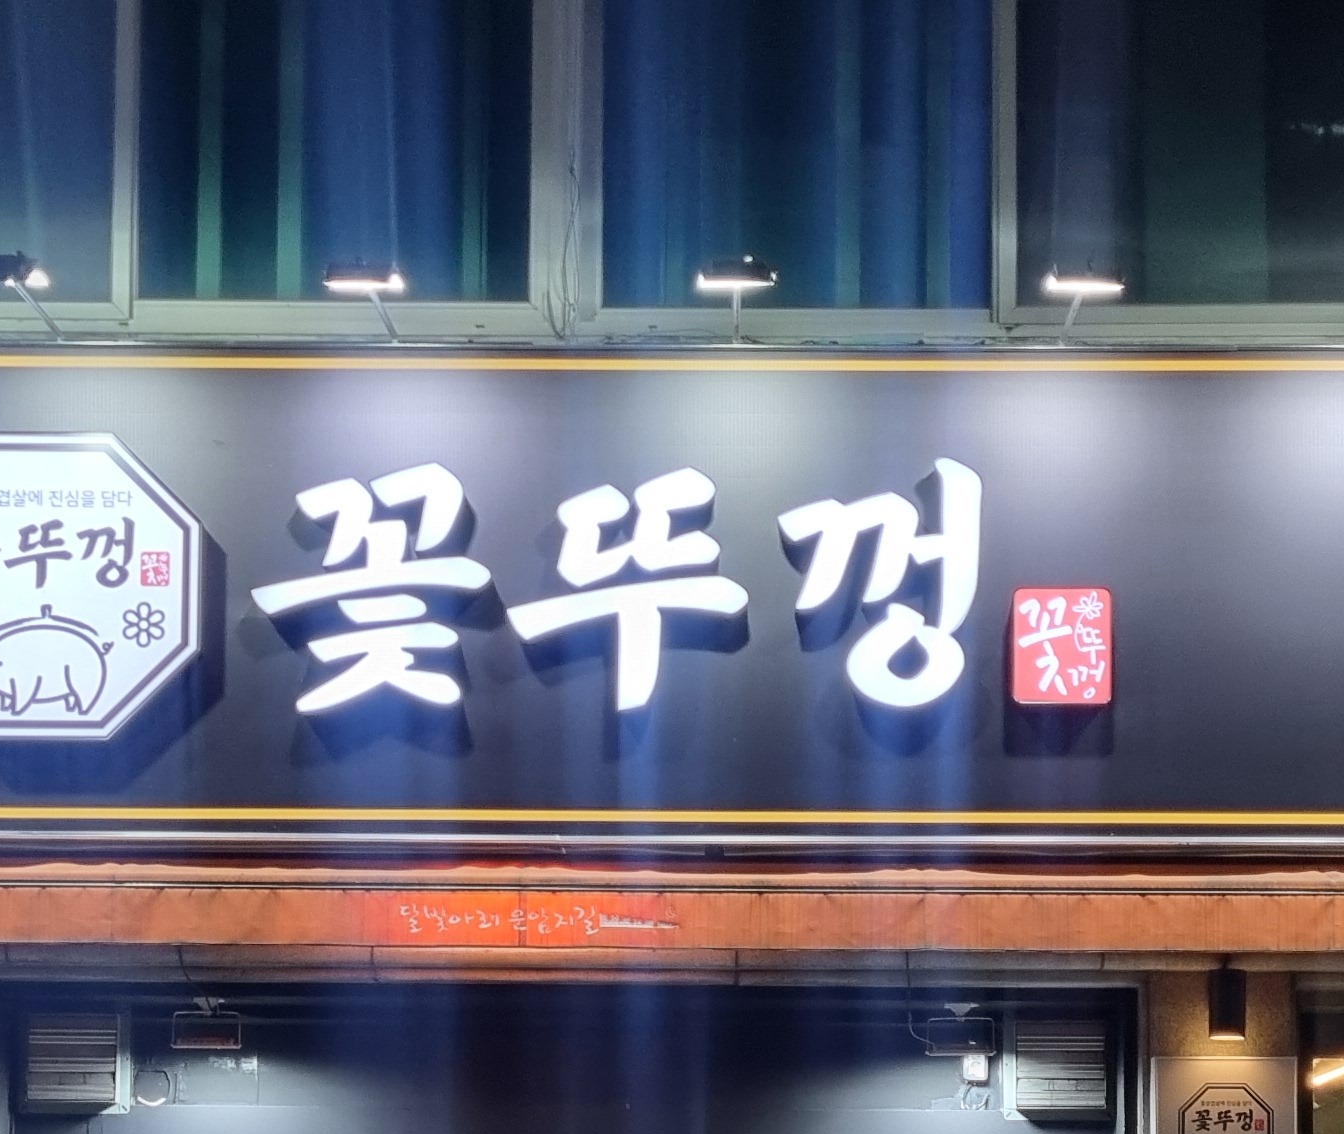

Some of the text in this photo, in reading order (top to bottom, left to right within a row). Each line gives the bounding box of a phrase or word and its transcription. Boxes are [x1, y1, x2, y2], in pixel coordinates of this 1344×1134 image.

[48, 490, 96, 508] 진심을
[101, 490, 133, 508] 담다
[252, 456, 984, 711] 꽃뚜껑
[400, 904, 599, 936] 달빛아래 운암지길
[1191, 1109, 1254, 1131] 꽃뚜껑
